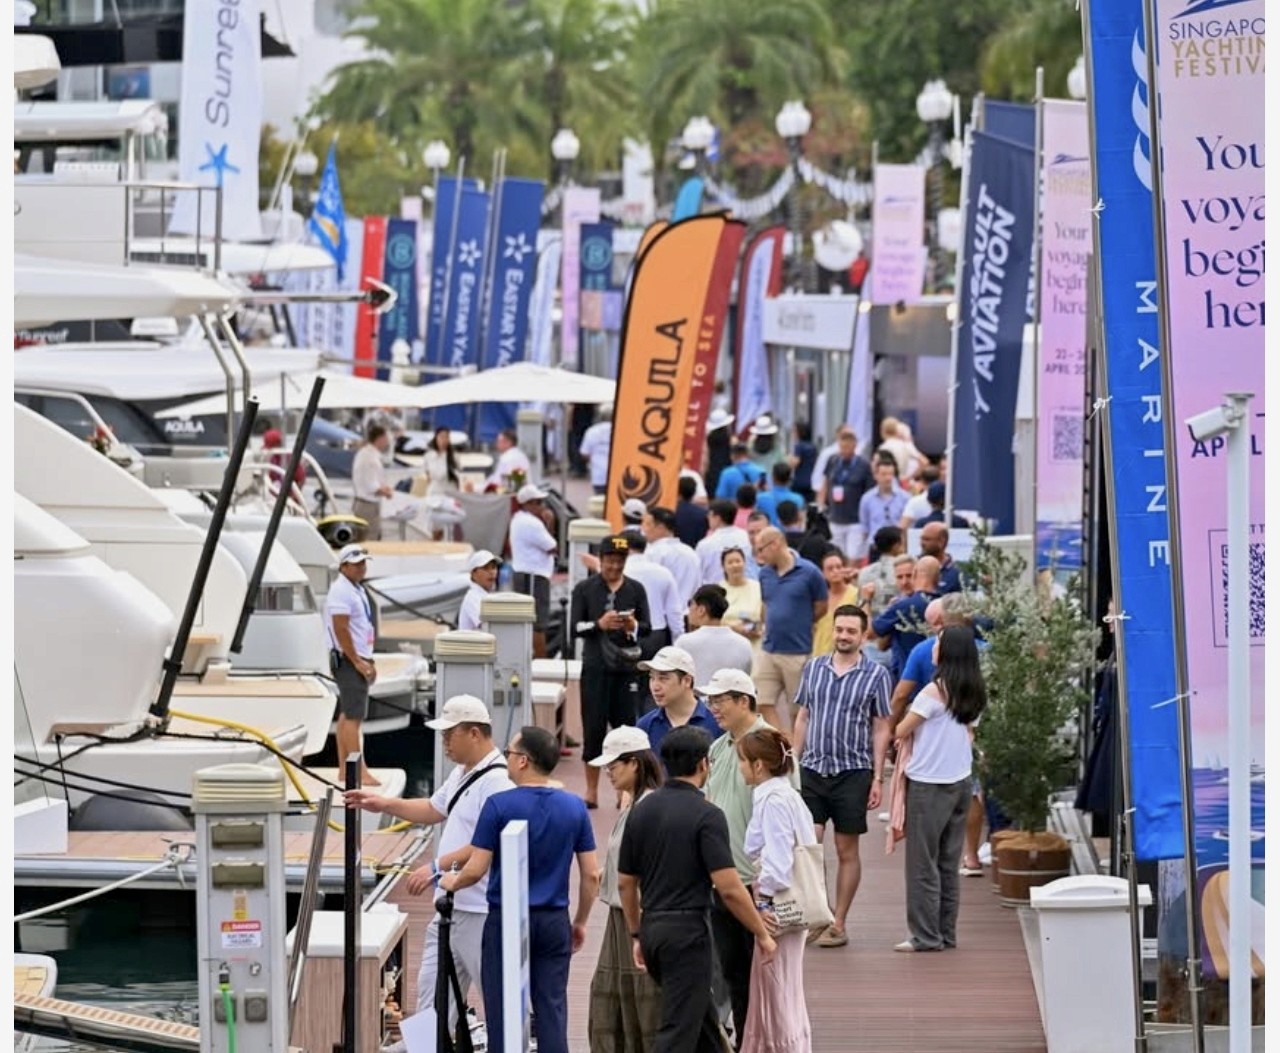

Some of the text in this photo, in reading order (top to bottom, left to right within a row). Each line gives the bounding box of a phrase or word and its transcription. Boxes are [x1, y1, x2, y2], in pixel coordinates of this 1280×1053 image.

[205, 0, 240, 128] Sunre
[1174, 56, 1265, 79] FESTIV
[1053, 221, 1089, 241] Your
[454, 272, 476, 334] EASTAR
[500, 268, 524, 335] EASTAR
[972, 206, 1016, 382] AVIATION
[699, 315, 716, 351] SEA
[638, 317, 688, 461] AQUILA
[164, 421, 205, 434] AQUILA
[1135, 281, 1170, 567] MARINE
[1191, 434, 1262, 459] APL
